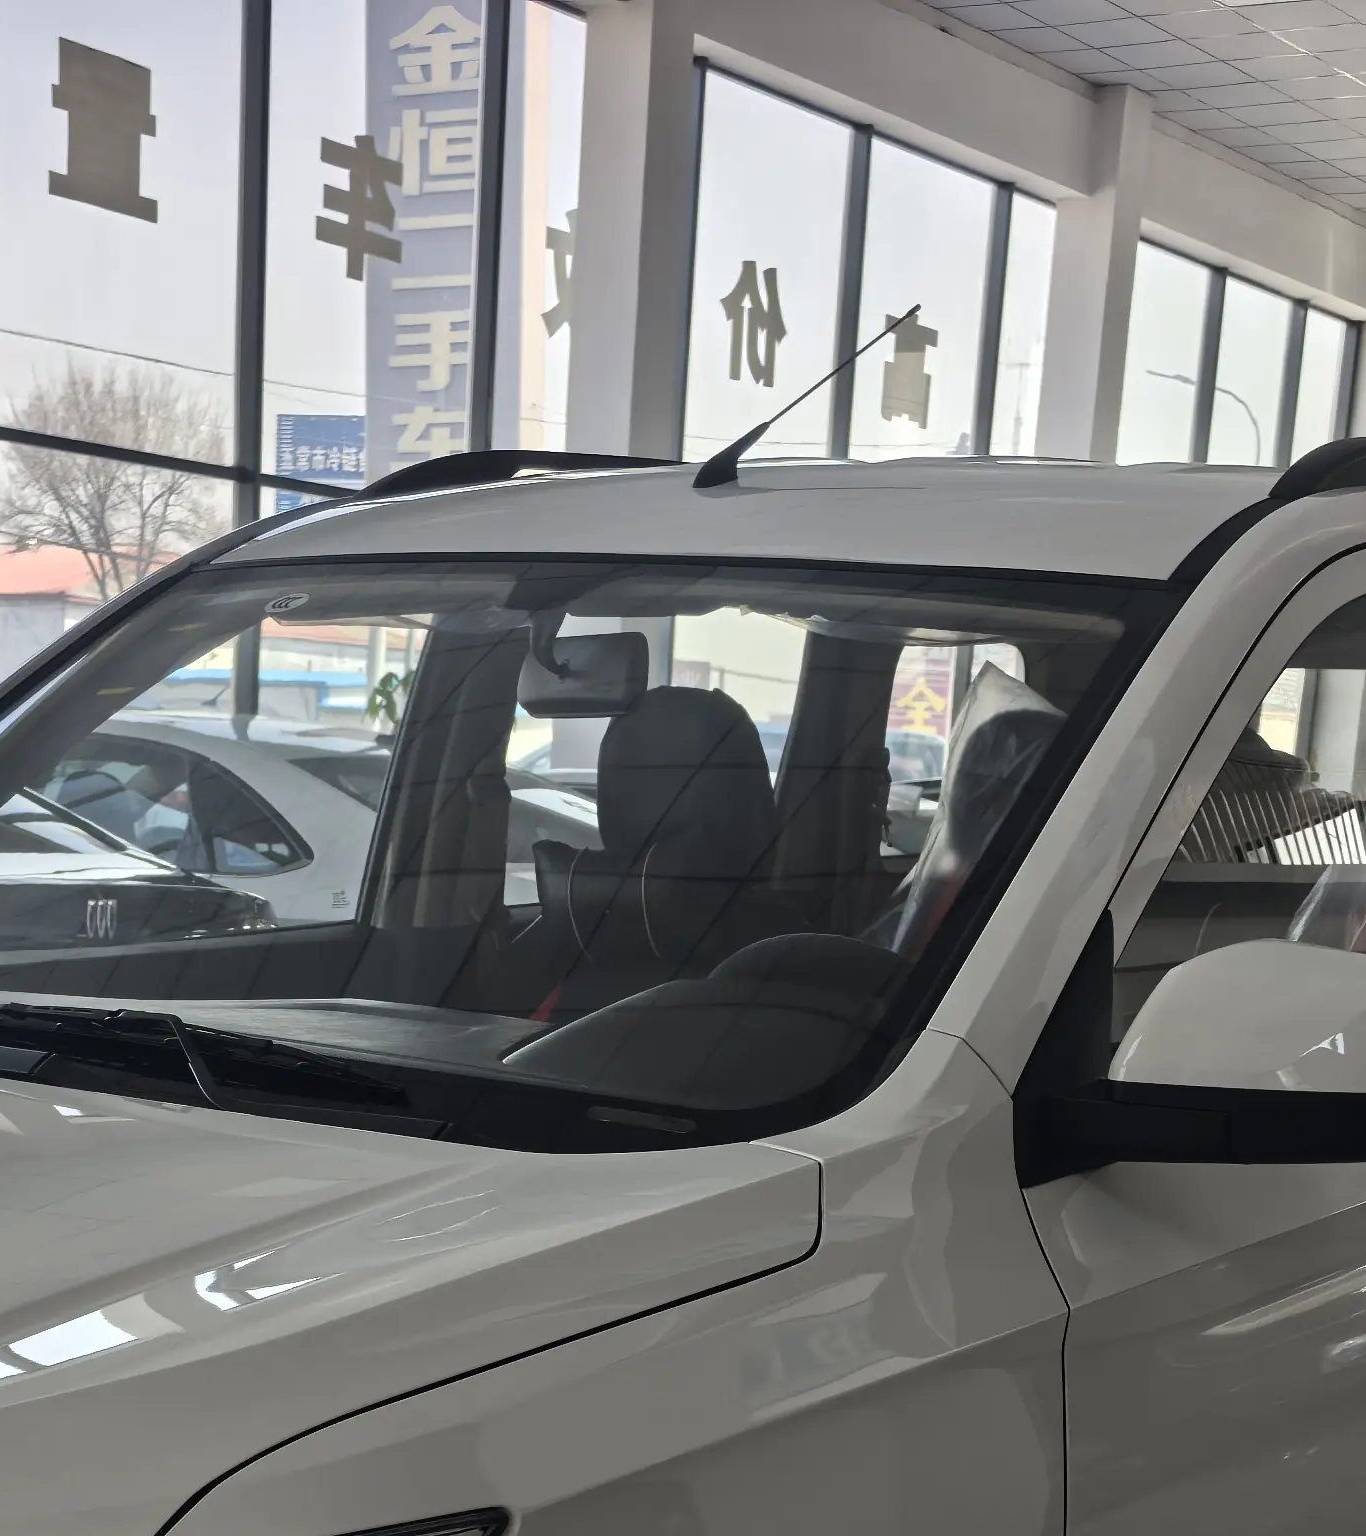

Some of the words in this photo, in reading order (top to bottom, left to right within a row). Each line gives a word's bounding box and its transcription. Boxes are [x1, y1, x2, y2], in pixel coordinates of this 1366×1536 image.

[388, 5, 481, 474] 金恒二手车
